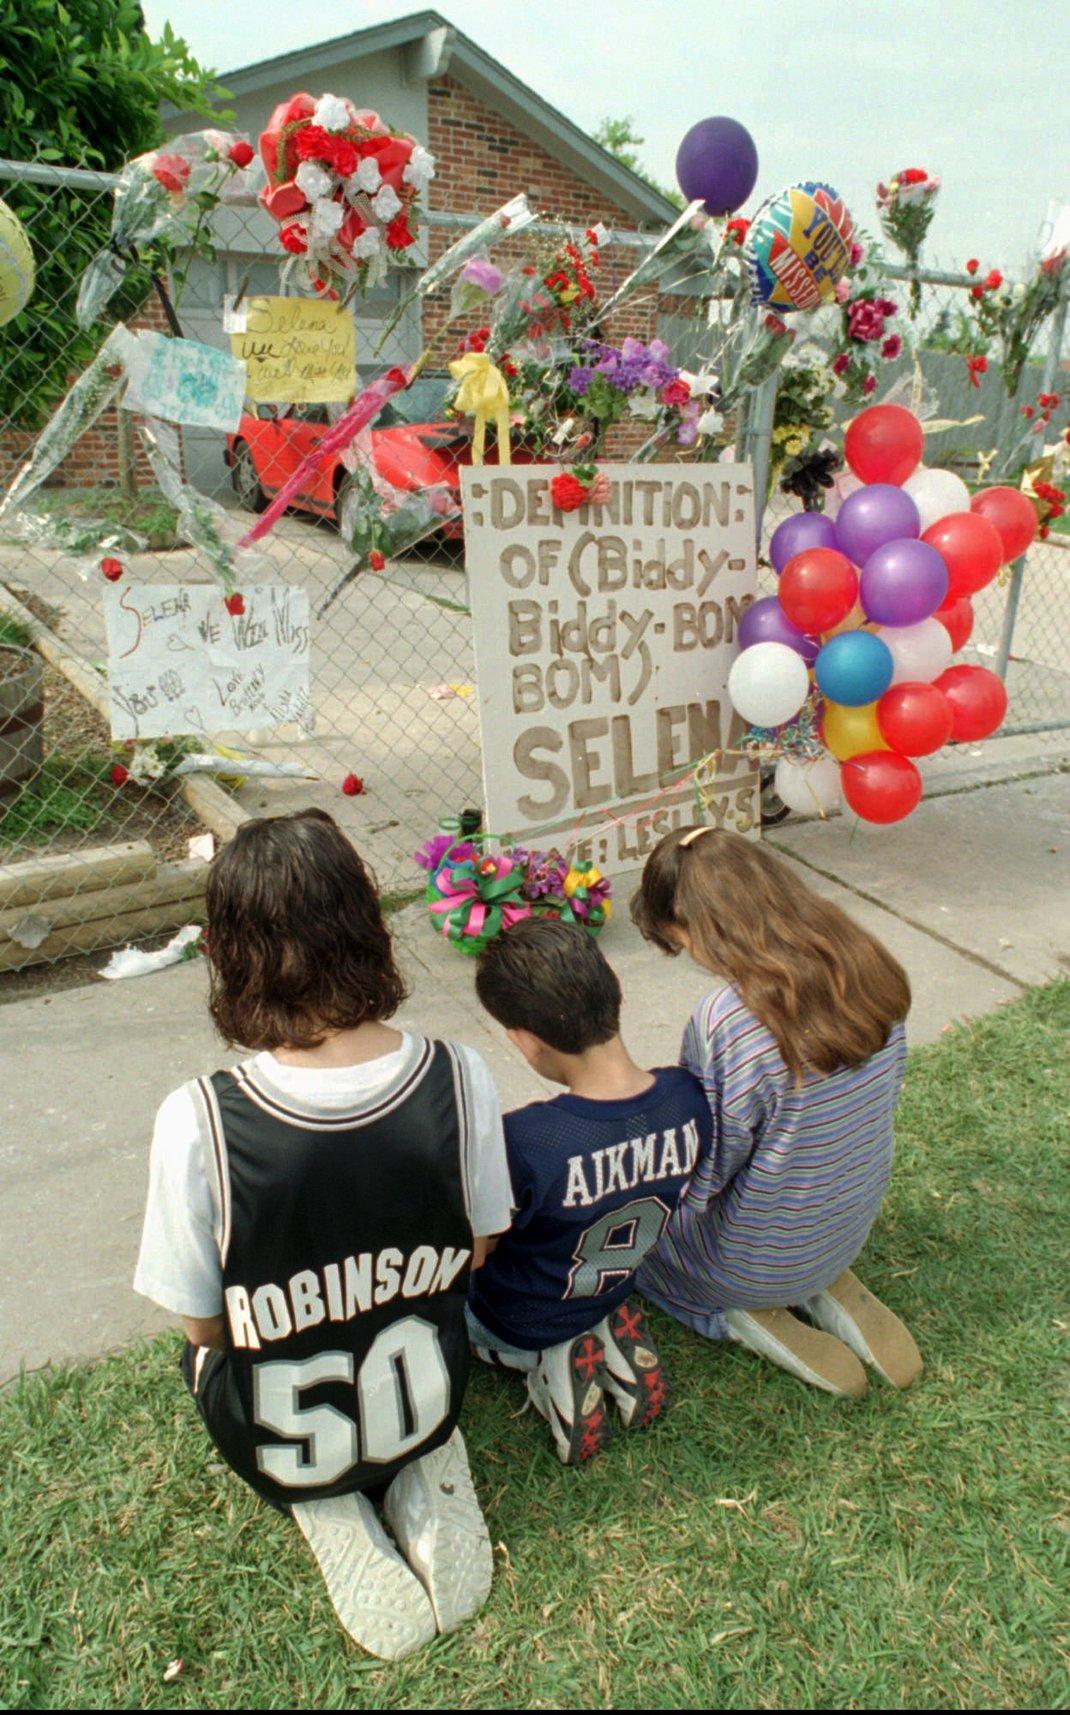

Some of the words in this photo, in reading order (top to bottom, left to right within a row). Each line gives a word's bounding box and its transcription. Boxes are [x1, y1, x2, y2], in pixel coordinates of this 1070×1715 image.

[499, 539, 562, 589] OF
[512, 639, 652, 714] BOM)
[562, 1118, 698, 1208] AIKMAN
[560, 1196, 672, 1300] 8
[224, 1245, 471, 1350] ROBINSON
[252, 1313, 451, 1488] 50
